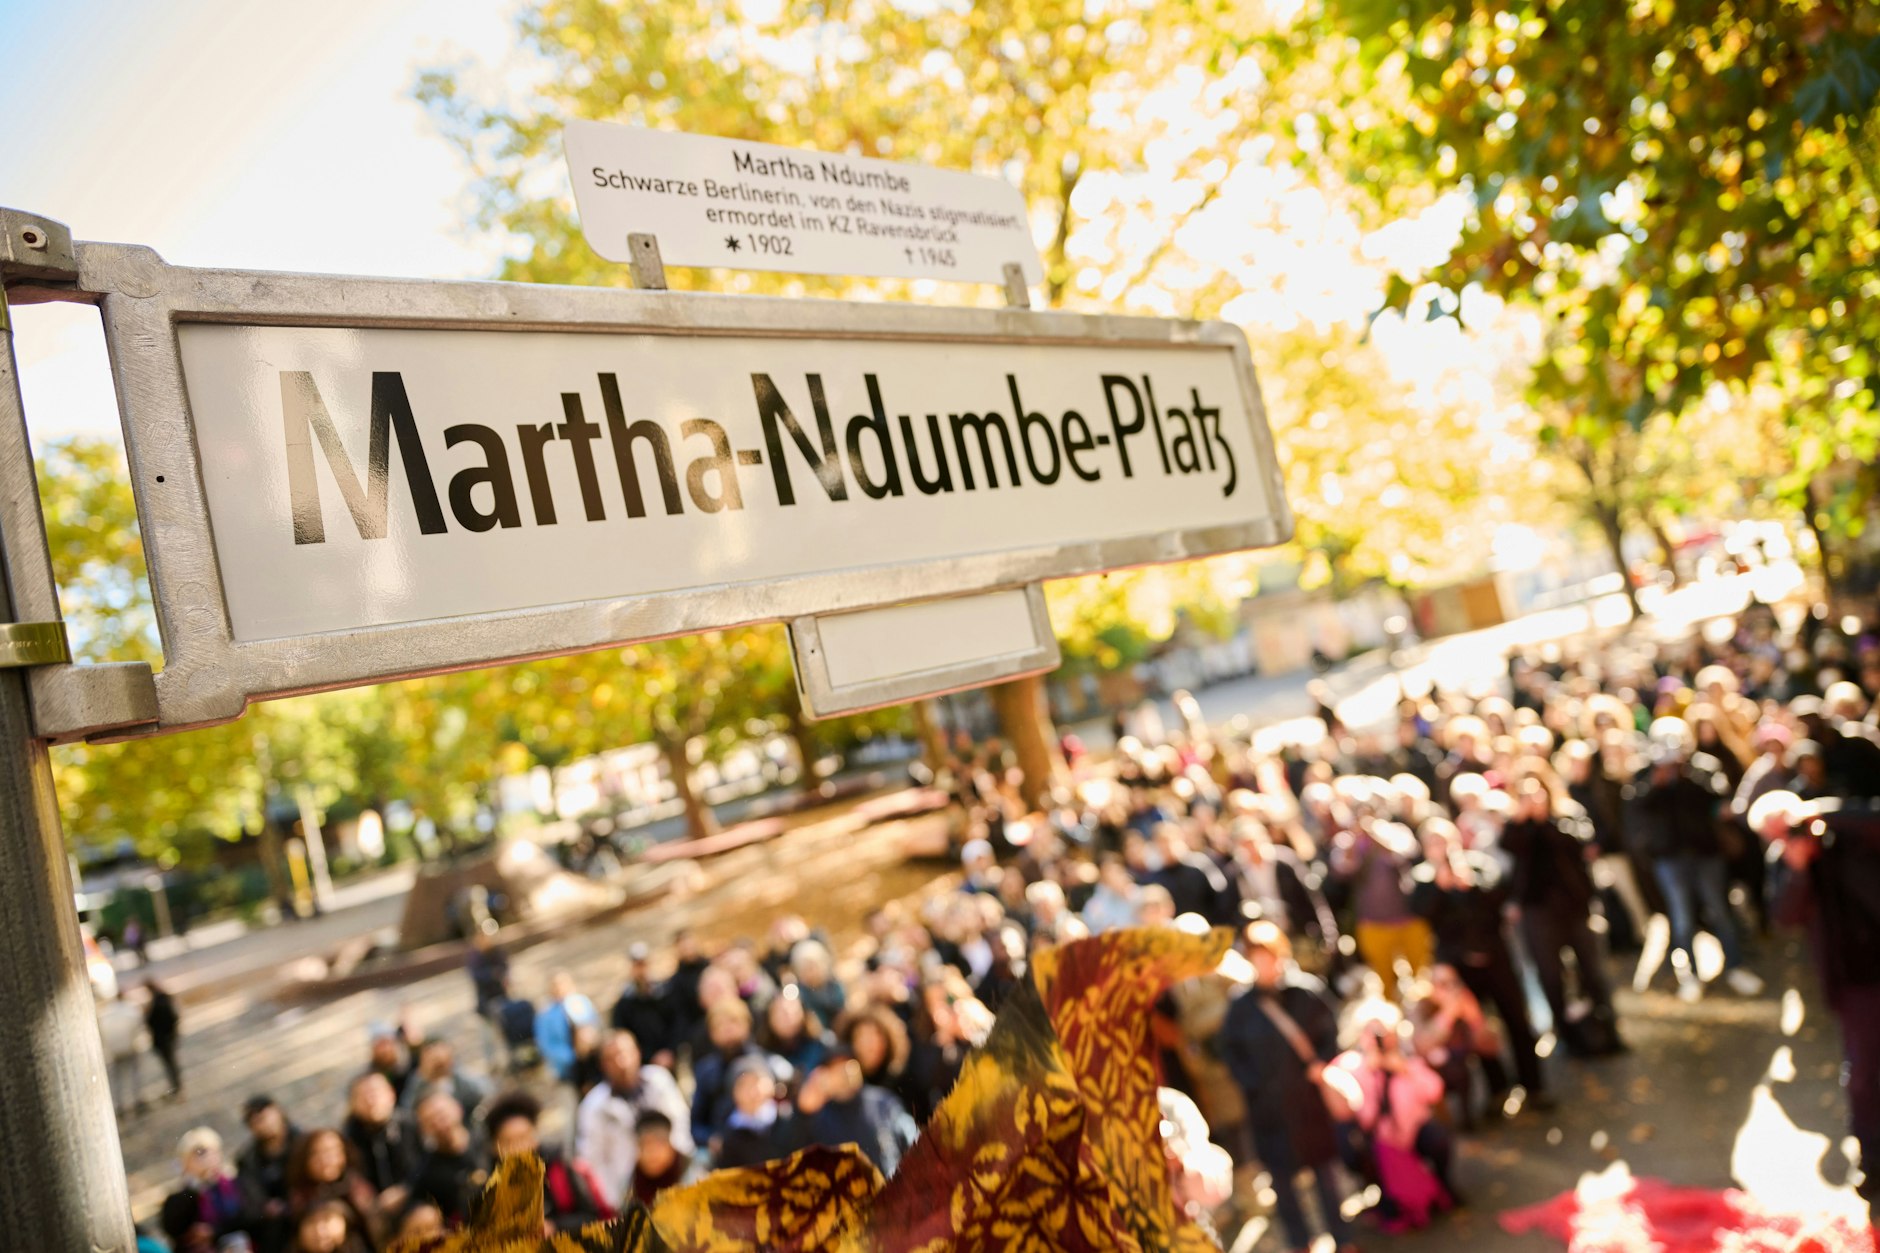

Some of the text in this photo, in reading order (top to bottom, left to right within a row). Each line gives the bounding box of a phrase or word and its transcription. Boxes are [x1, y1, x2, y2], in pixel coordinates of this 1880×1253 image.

[592, 167, 698, 196] Schwarze
[808, 195, 841, 211] von
[846, 196, 877, 214] den
[880, 200, 925, 219] Nazis
[732, 150, 911, 193] Martha Ndumbe
[706, 208, 959, 243] ermordet im KZ Ravensbrück
[280, 371, 1237, 545] Martha-Ndumbe-Platz
